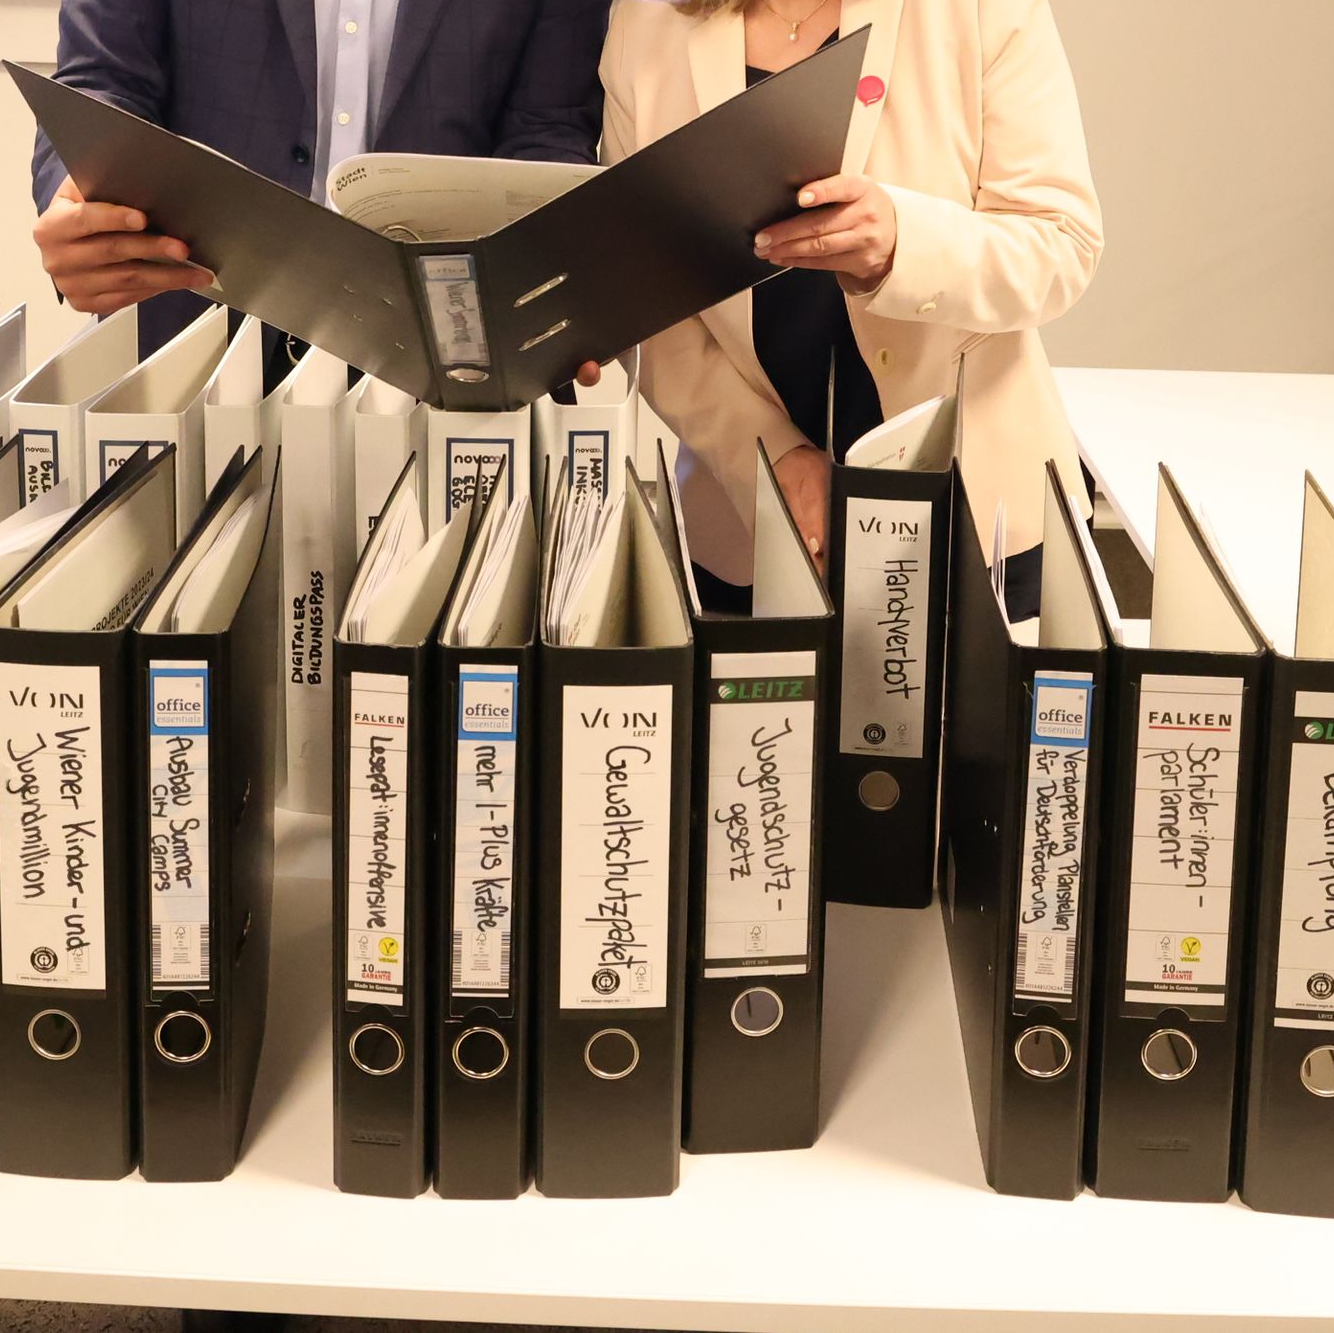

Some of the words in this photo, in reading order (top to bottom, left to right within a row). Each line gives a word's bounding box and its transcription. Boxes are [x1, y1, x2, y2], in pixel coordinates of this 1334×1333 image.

[335, 167, 366, 186] Stadt
[337, 173, 368, 192] Wien
[291, 593, 307, 684] DIGITALER
[307, 570, 325, 685] BILDUNGSPASS
[877, 560, 921, 699] Handyverbot
[738, 681, 804, 700] LEITZ
[156, 698, 201, 712] office
[465, 703, 510, 717] office
[1039, 709, 1083, 724] office
[157, 714, 202, 724] essentials
[354, 713, 405, 725] FALKEN
[464, 719, 510, 730] essentials
[1148, 711, 1232, 726] FALKEN
[1037, 725, 1082, 737] essentials
[55, 726, 90, 810] Wiener
[167, 736, 193, 806] Ausbau
[474, 745, 496, 792] mehr
[1036, 749, 1059, 776] für
[6, 733, 50, 899] Jugendmillion
[737, 718, 796, 912] Jugendschutz-
[1142, 749, 1184, 869] parlament
[170, 818, 200, 889] Summer
[715, 803, 755, 881] gesetz
[151, 834, 170, 892] Camps
[585, 745, 651, 969] Gewaltschutzpaket
[472, 878, 510, 933] Kräfte
[1052, 859, 1079, 932] Planstellen
[65, 914, 91, 951] und
[361, 963, 375, 972] 10
[361, 972, 392, 981] GARANTIE
[1162, 964, 1175, 973] 10
[1162, 973, 1193, 981] GARANTIE
[375, 985, 398, 993] Germany
[1175, 985, 1198, 993] Germany
